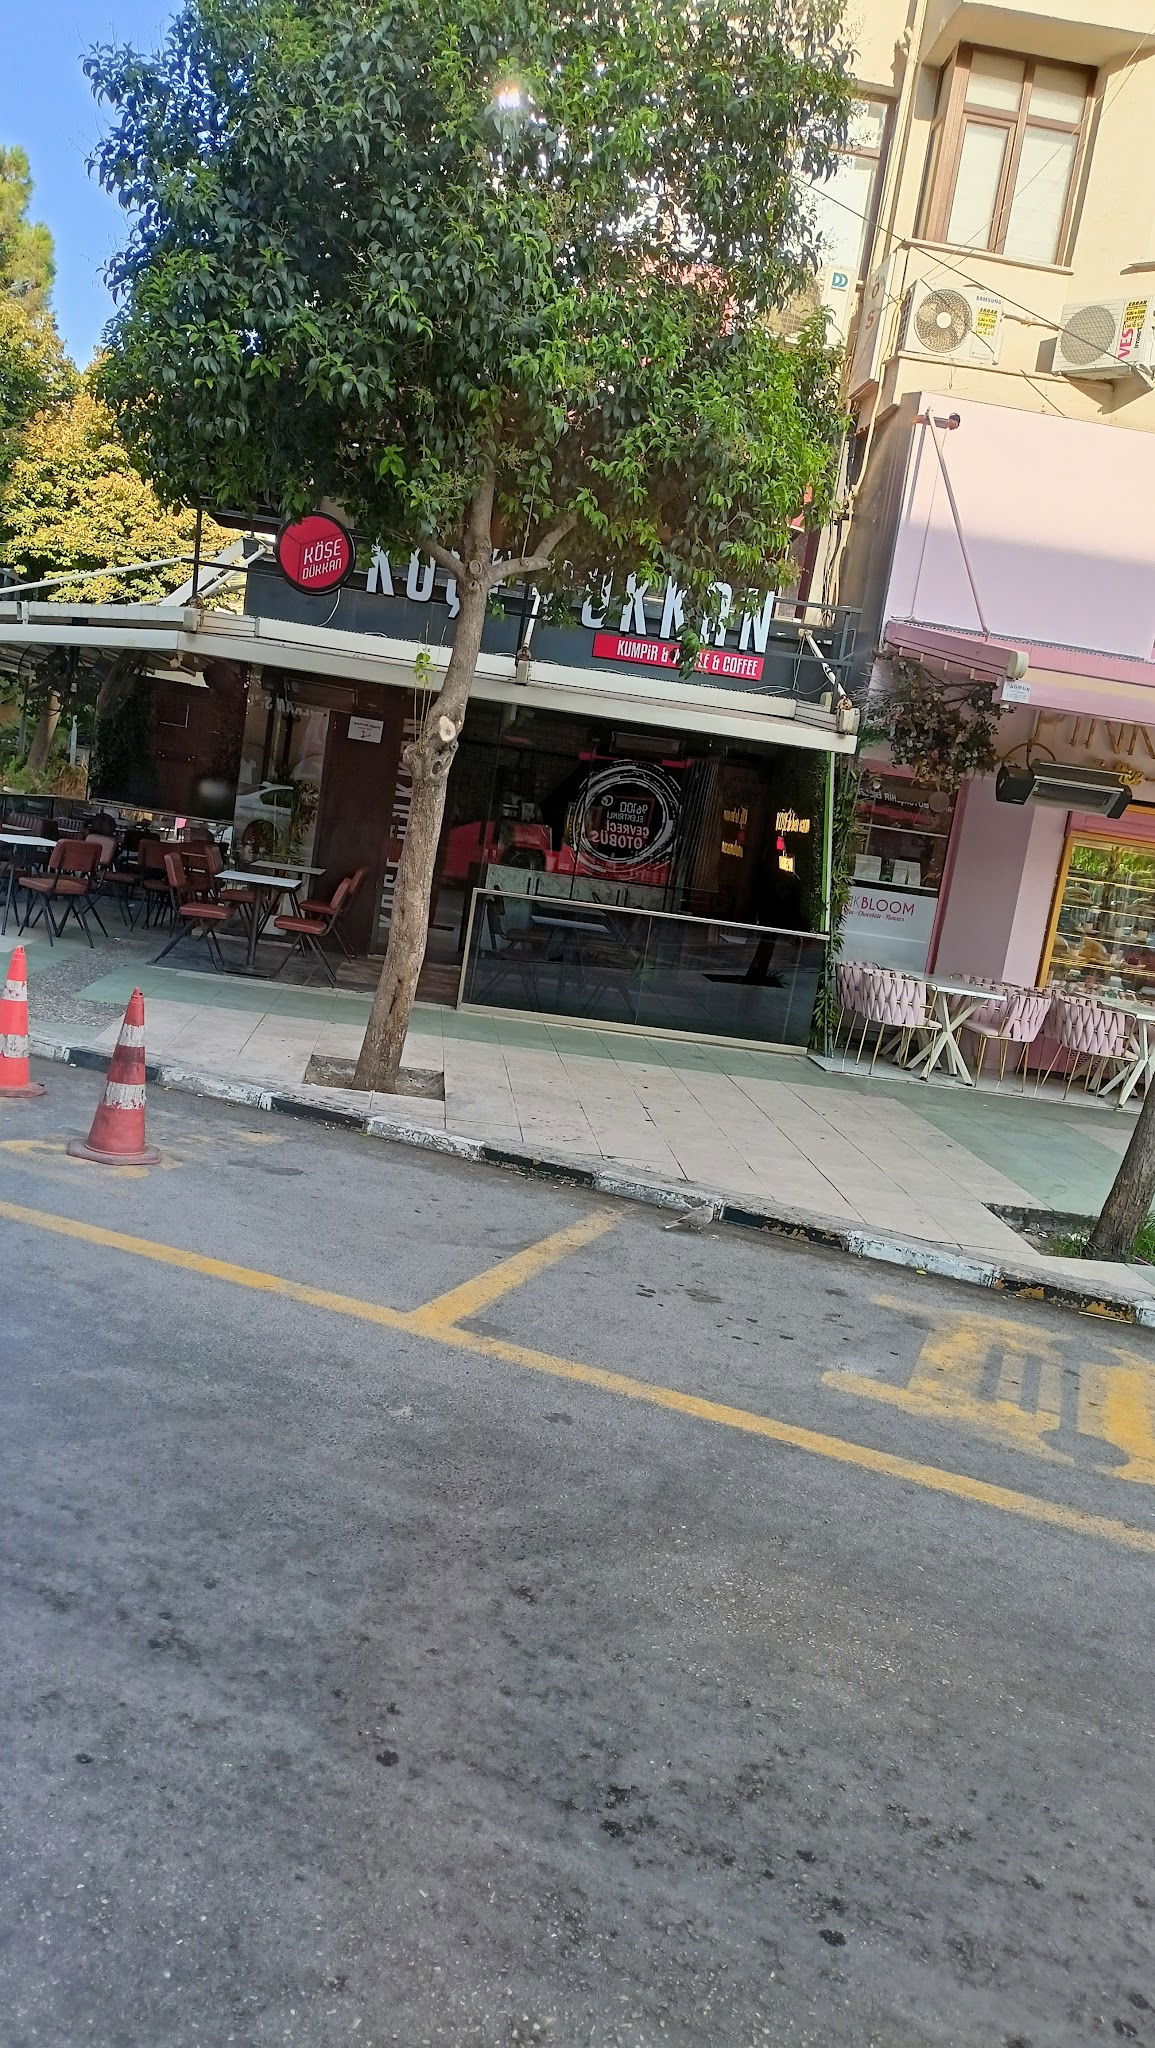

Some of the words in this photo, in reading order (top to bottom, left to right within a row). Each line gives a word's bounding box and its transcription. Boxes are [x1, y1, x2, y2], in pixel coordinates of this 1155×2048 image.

[976, 295, 1001, 304] SAMSUNG
[303, 538, 342, 565] KÖŞE
[302, 558, 342, 580] DÜKKAN
[711, 657, 720, 671] &
[722, 656, 759, 677] COFFEE
